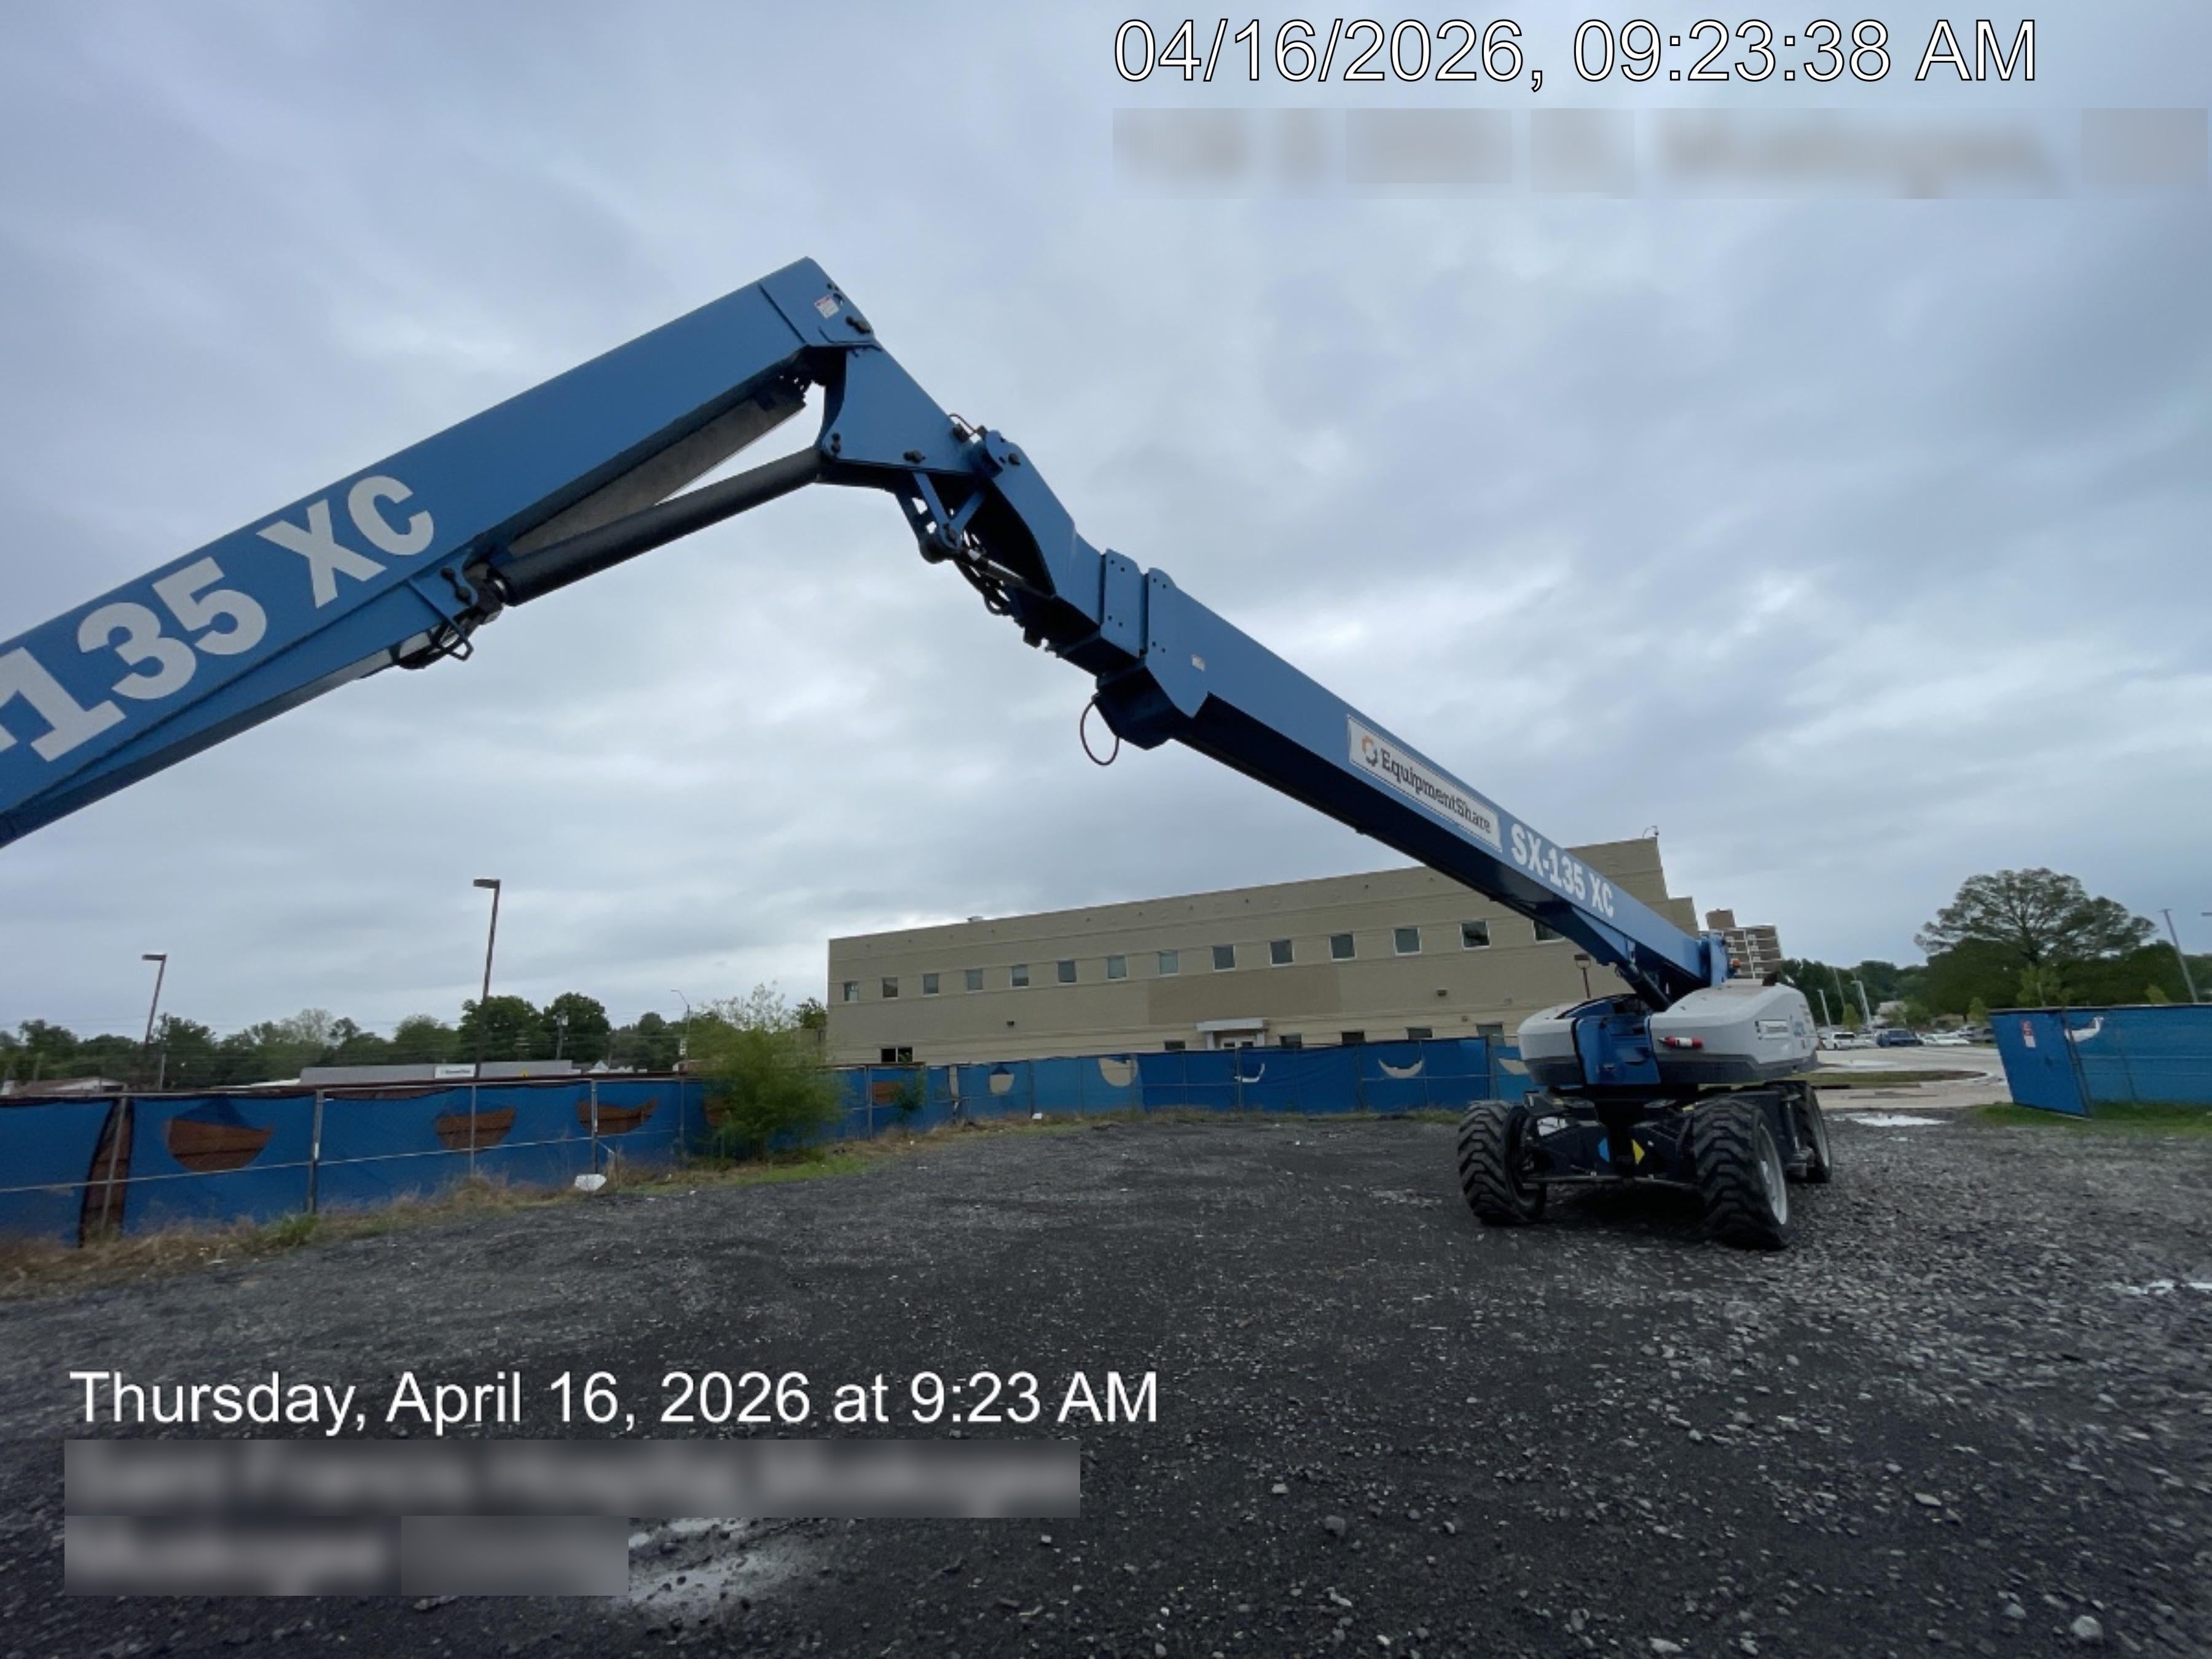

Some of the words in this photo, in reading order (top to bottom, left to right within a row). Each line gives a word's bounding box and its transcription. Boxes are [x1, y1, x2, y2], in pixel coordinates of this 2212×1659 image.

[0, 557, 268, 763] 135
[255, 475, 434, 609] XC
[1381, 747, 1492, 834] EquipmentShare
[1511, 823, 1586, 900] SX-135
[1589, 872, 1614, 919] XC
